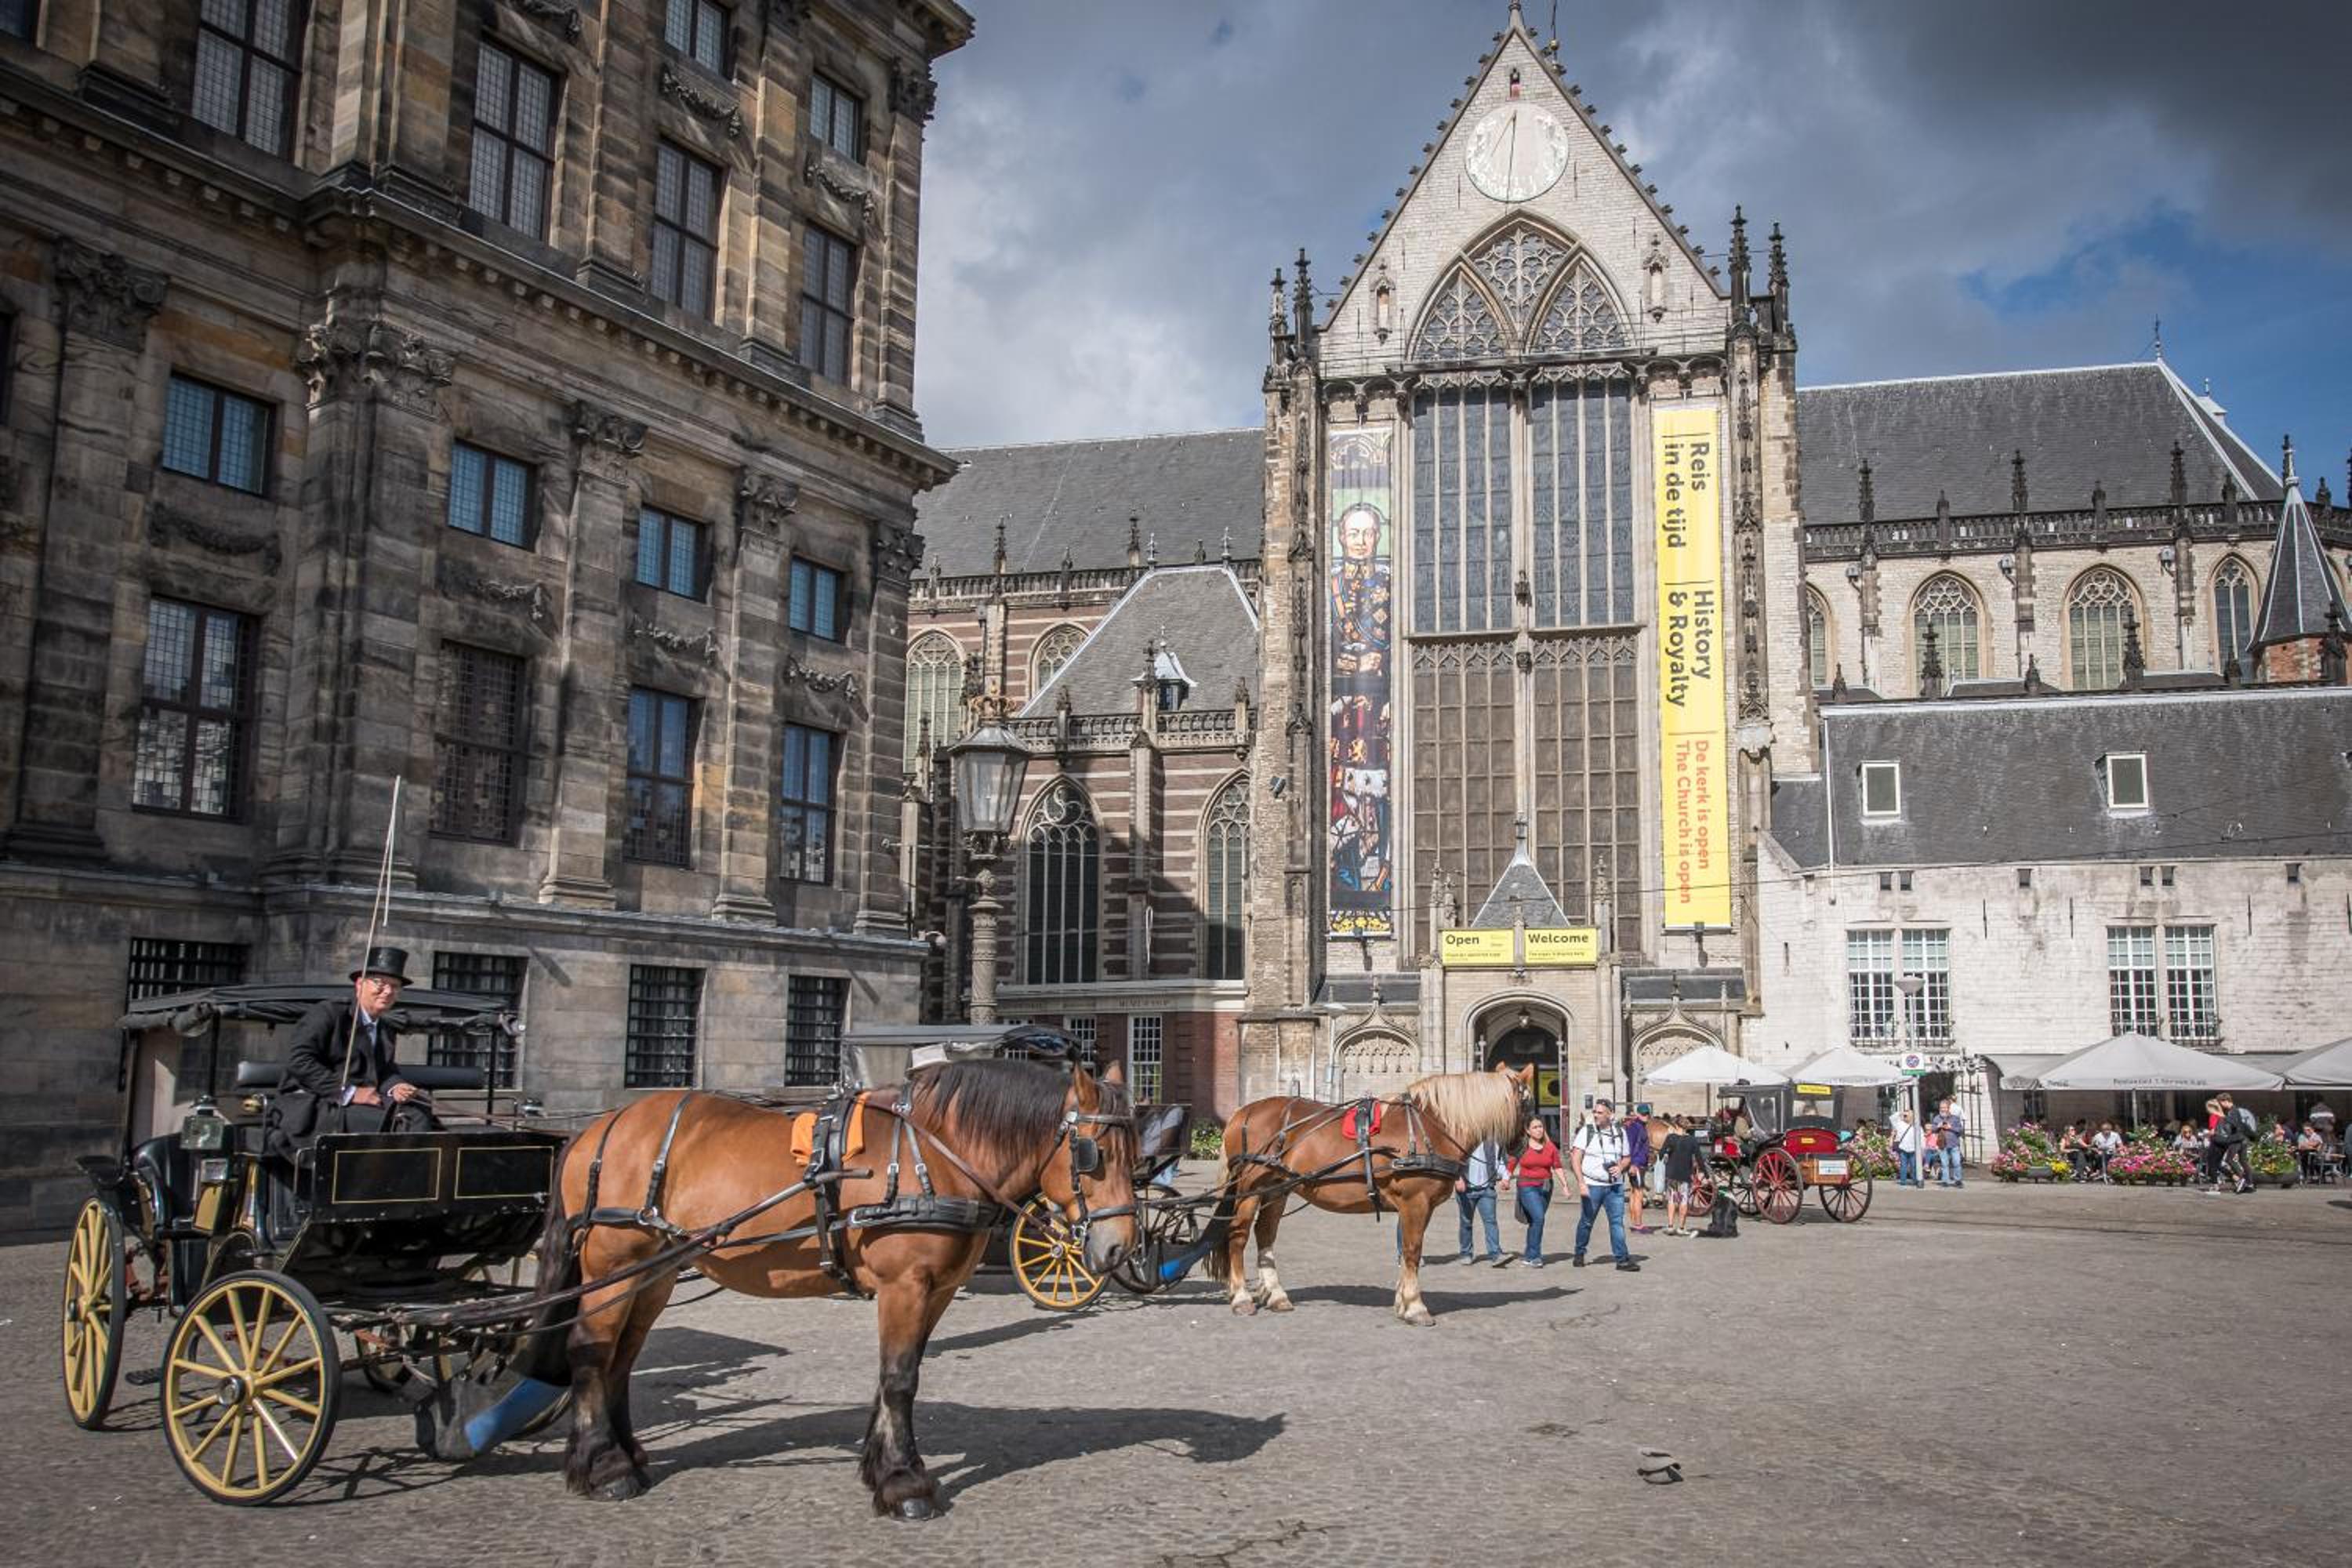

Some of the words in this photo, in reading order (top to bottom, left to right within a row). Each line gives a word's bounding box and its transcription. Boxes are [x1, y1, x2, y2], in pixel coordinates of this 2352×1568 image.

[1664, 444, 1684, 466] in
[1690, 441, 1711, 491] Reis
[1666, 473, 1685, 501] de
[1662, 507, 1686, 548] tijd
[1668, 592, 1688, 608] &
[1691, 590, 1715, 679] History
[1664, 615, 1689, 707] Royalty
[1675, 740, 1690, 771] The
[1695, 740, 1709, 762] De
[1696, 767, 1711, 804] kerk
[1677, 777, 1692, 839] Church
[1697, 809, 1711, 822] is
[1679, 843, 1693, 856] is
[1694, 826, 1709, 869] open
[1676, 861, 1691, 904] open
[1445, 934, 1480, 947] Open
[1528, 933, 1589, 944] Welcome
